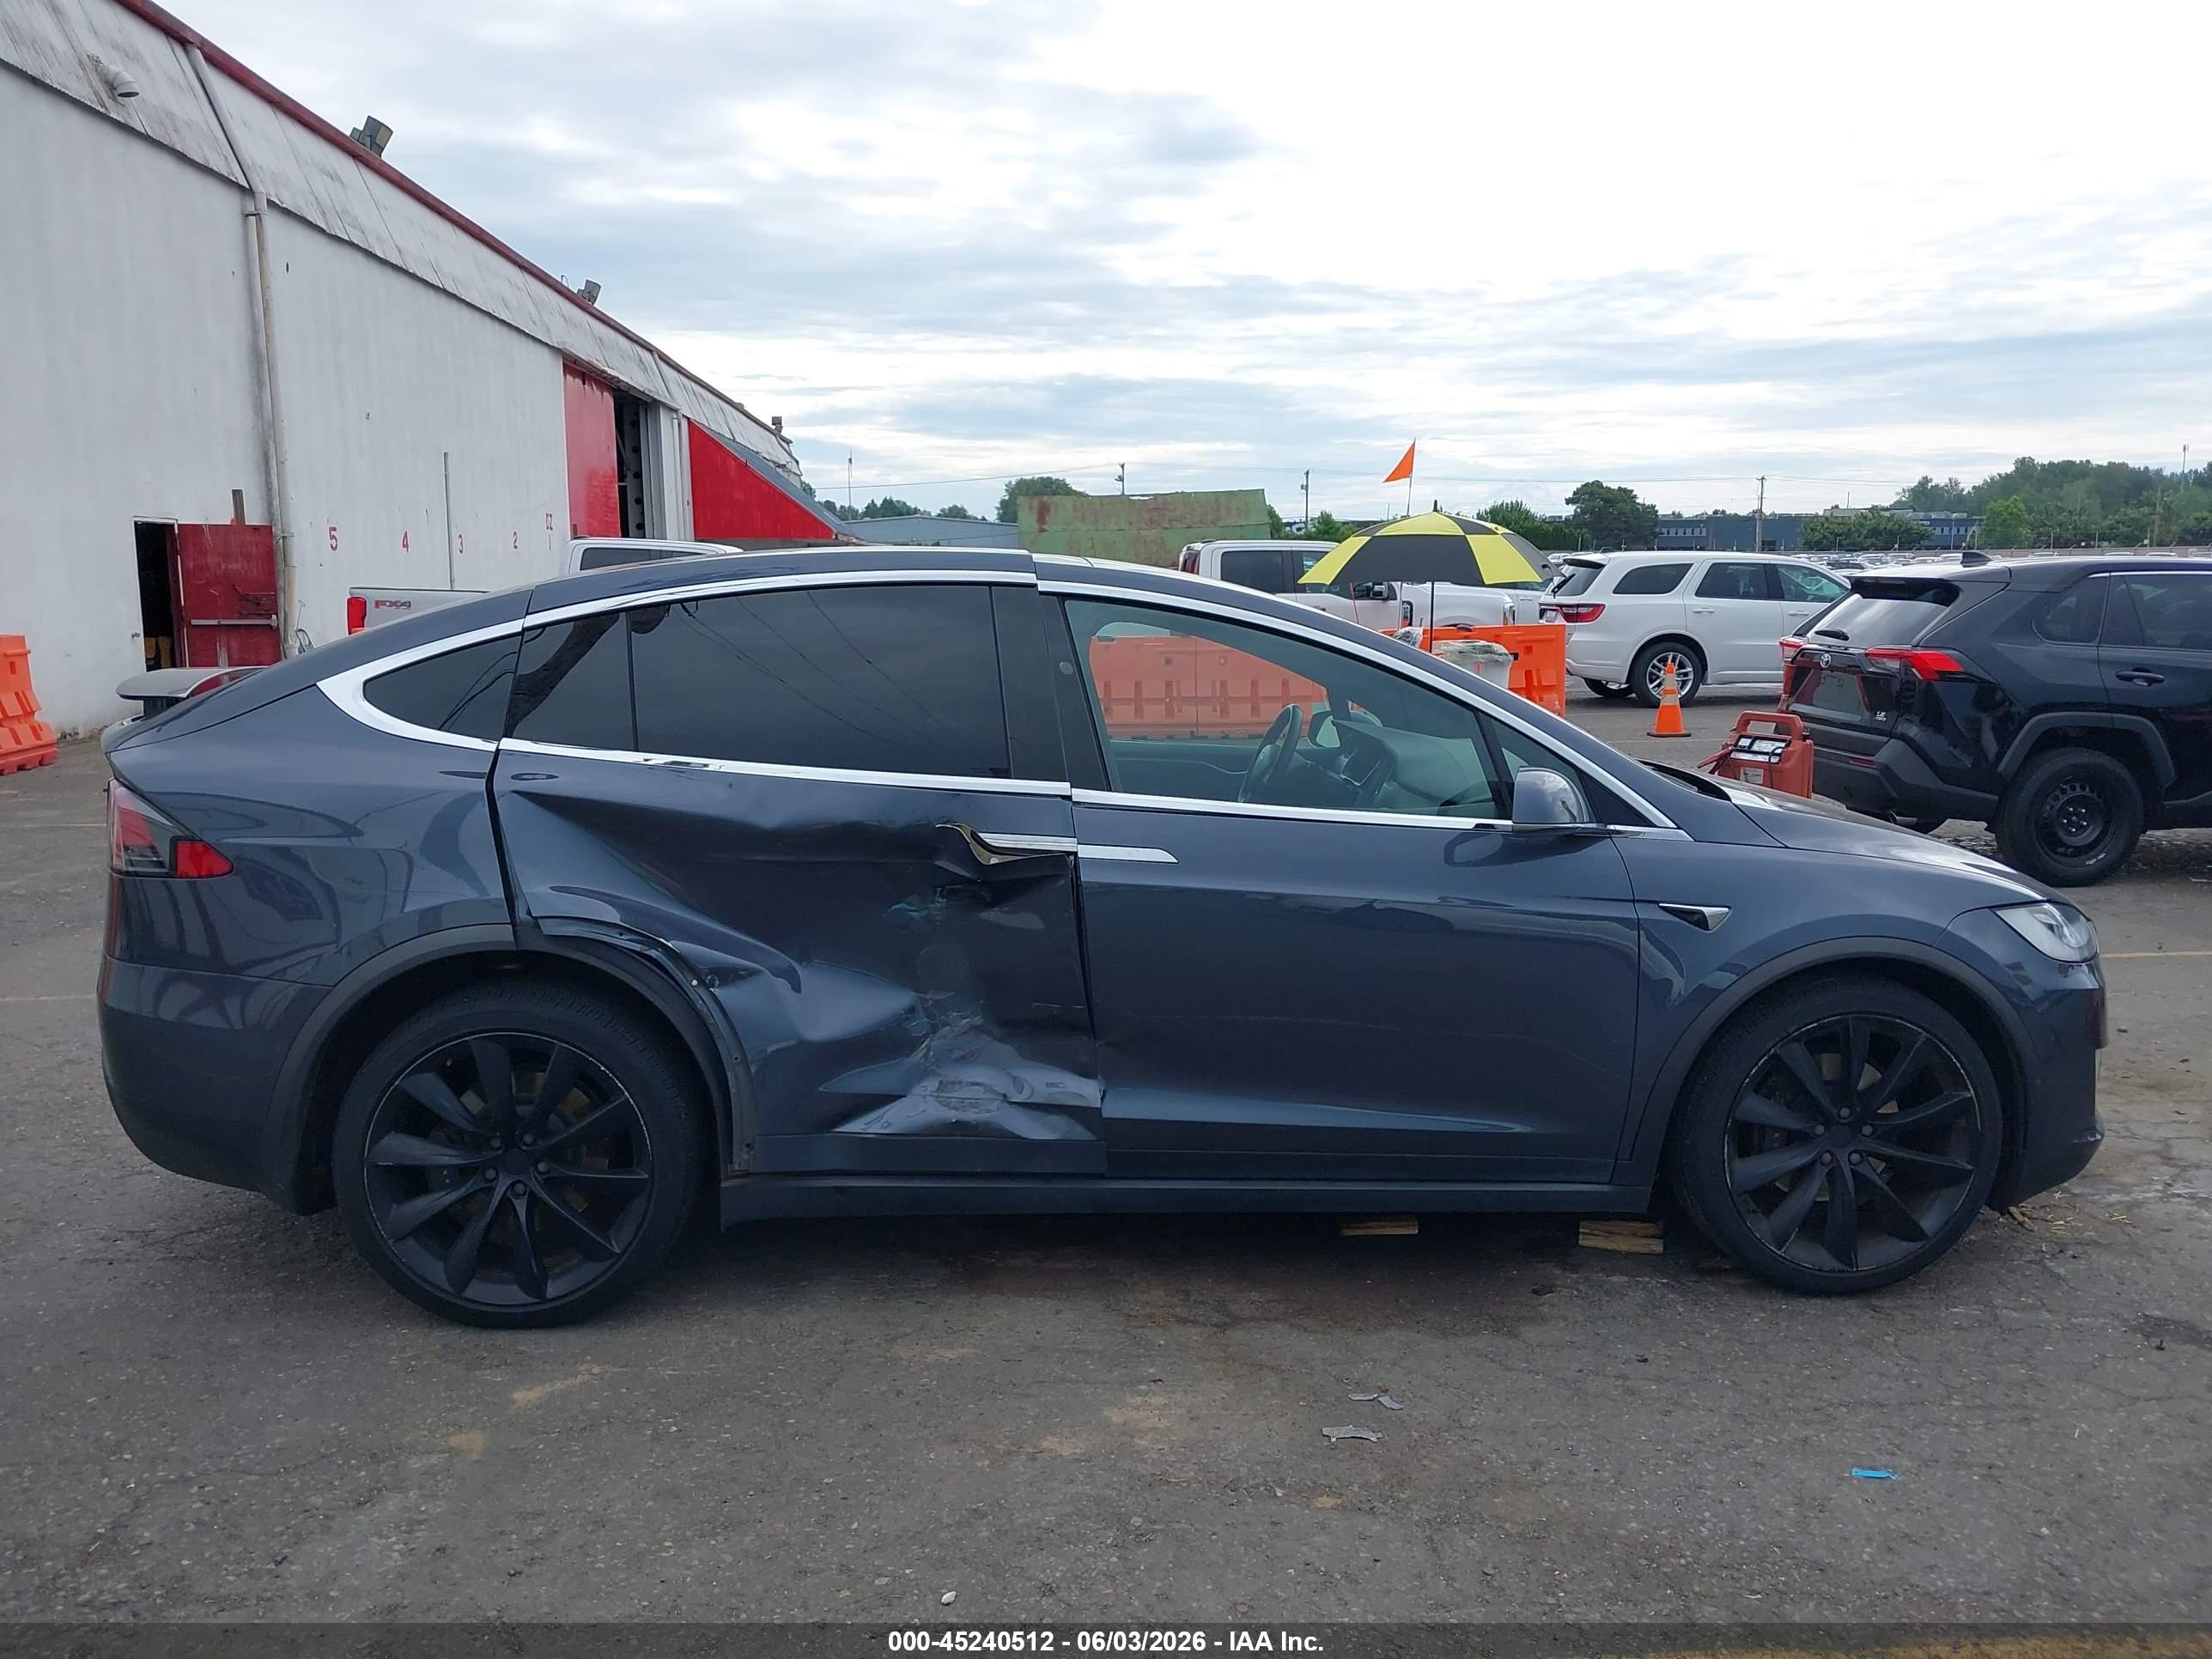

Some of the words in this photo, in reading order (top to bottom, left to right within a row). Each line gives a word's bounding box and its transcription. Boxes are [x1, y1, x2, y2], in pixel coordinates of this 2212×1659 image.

[328, 526, 338, 551] 5
[402, 530, 410, 553] 4
[458, 533, 464, 554] 3
[513, 531, 519, 550] 2
